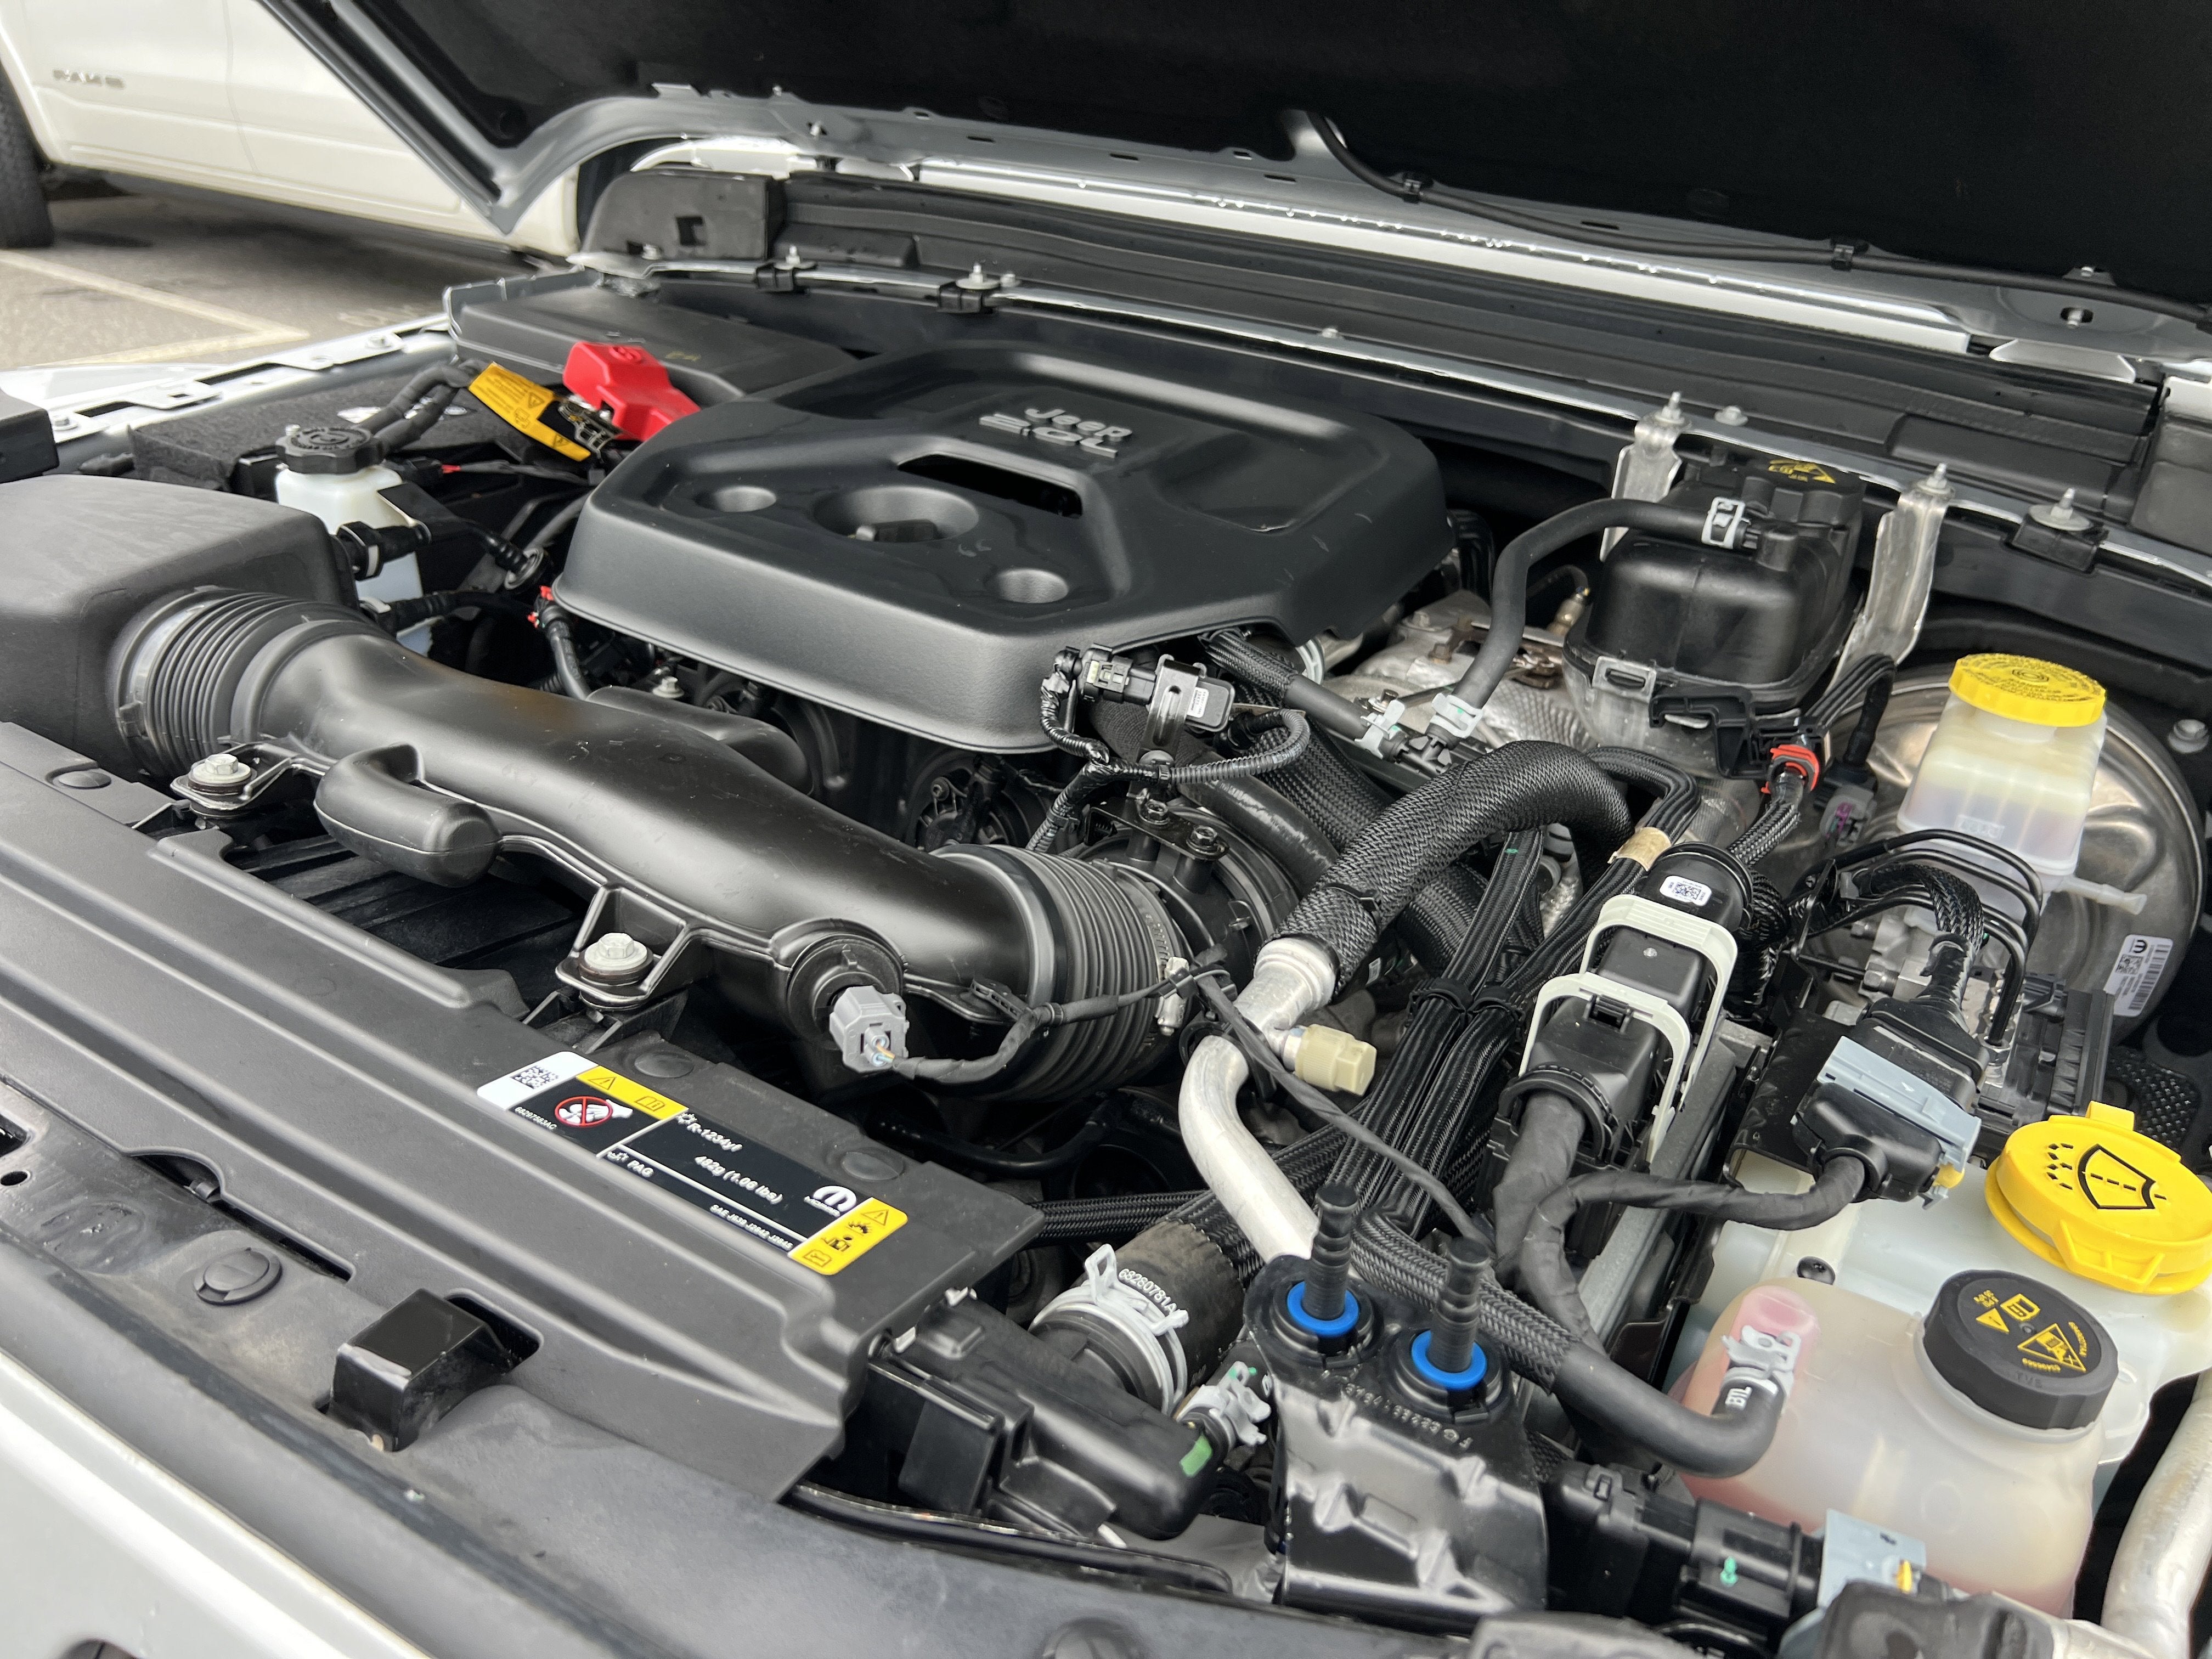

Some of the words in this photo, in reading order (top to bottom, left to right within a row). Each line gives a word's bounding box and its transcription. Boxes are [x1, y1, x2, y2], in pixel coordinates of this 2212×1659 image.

[979, 413, 1118, 459] 2.0L
[1024, 408, 1133, 442] Jeep
[515, 1107, 557, 1130] 68297583AC
[686, 1122, 743, 1153] R-1234yf
[627, 1160, 654, 1178] PAG
[694, 1156, 726, 1177] 482g
[723, 1170, 758, 1190] (1.06
[755, 1185, 783, 1205] lbs)
[710, 1204, 730, 1217] SAE
[1118, 1268, 1180, 1314] 68280781A
